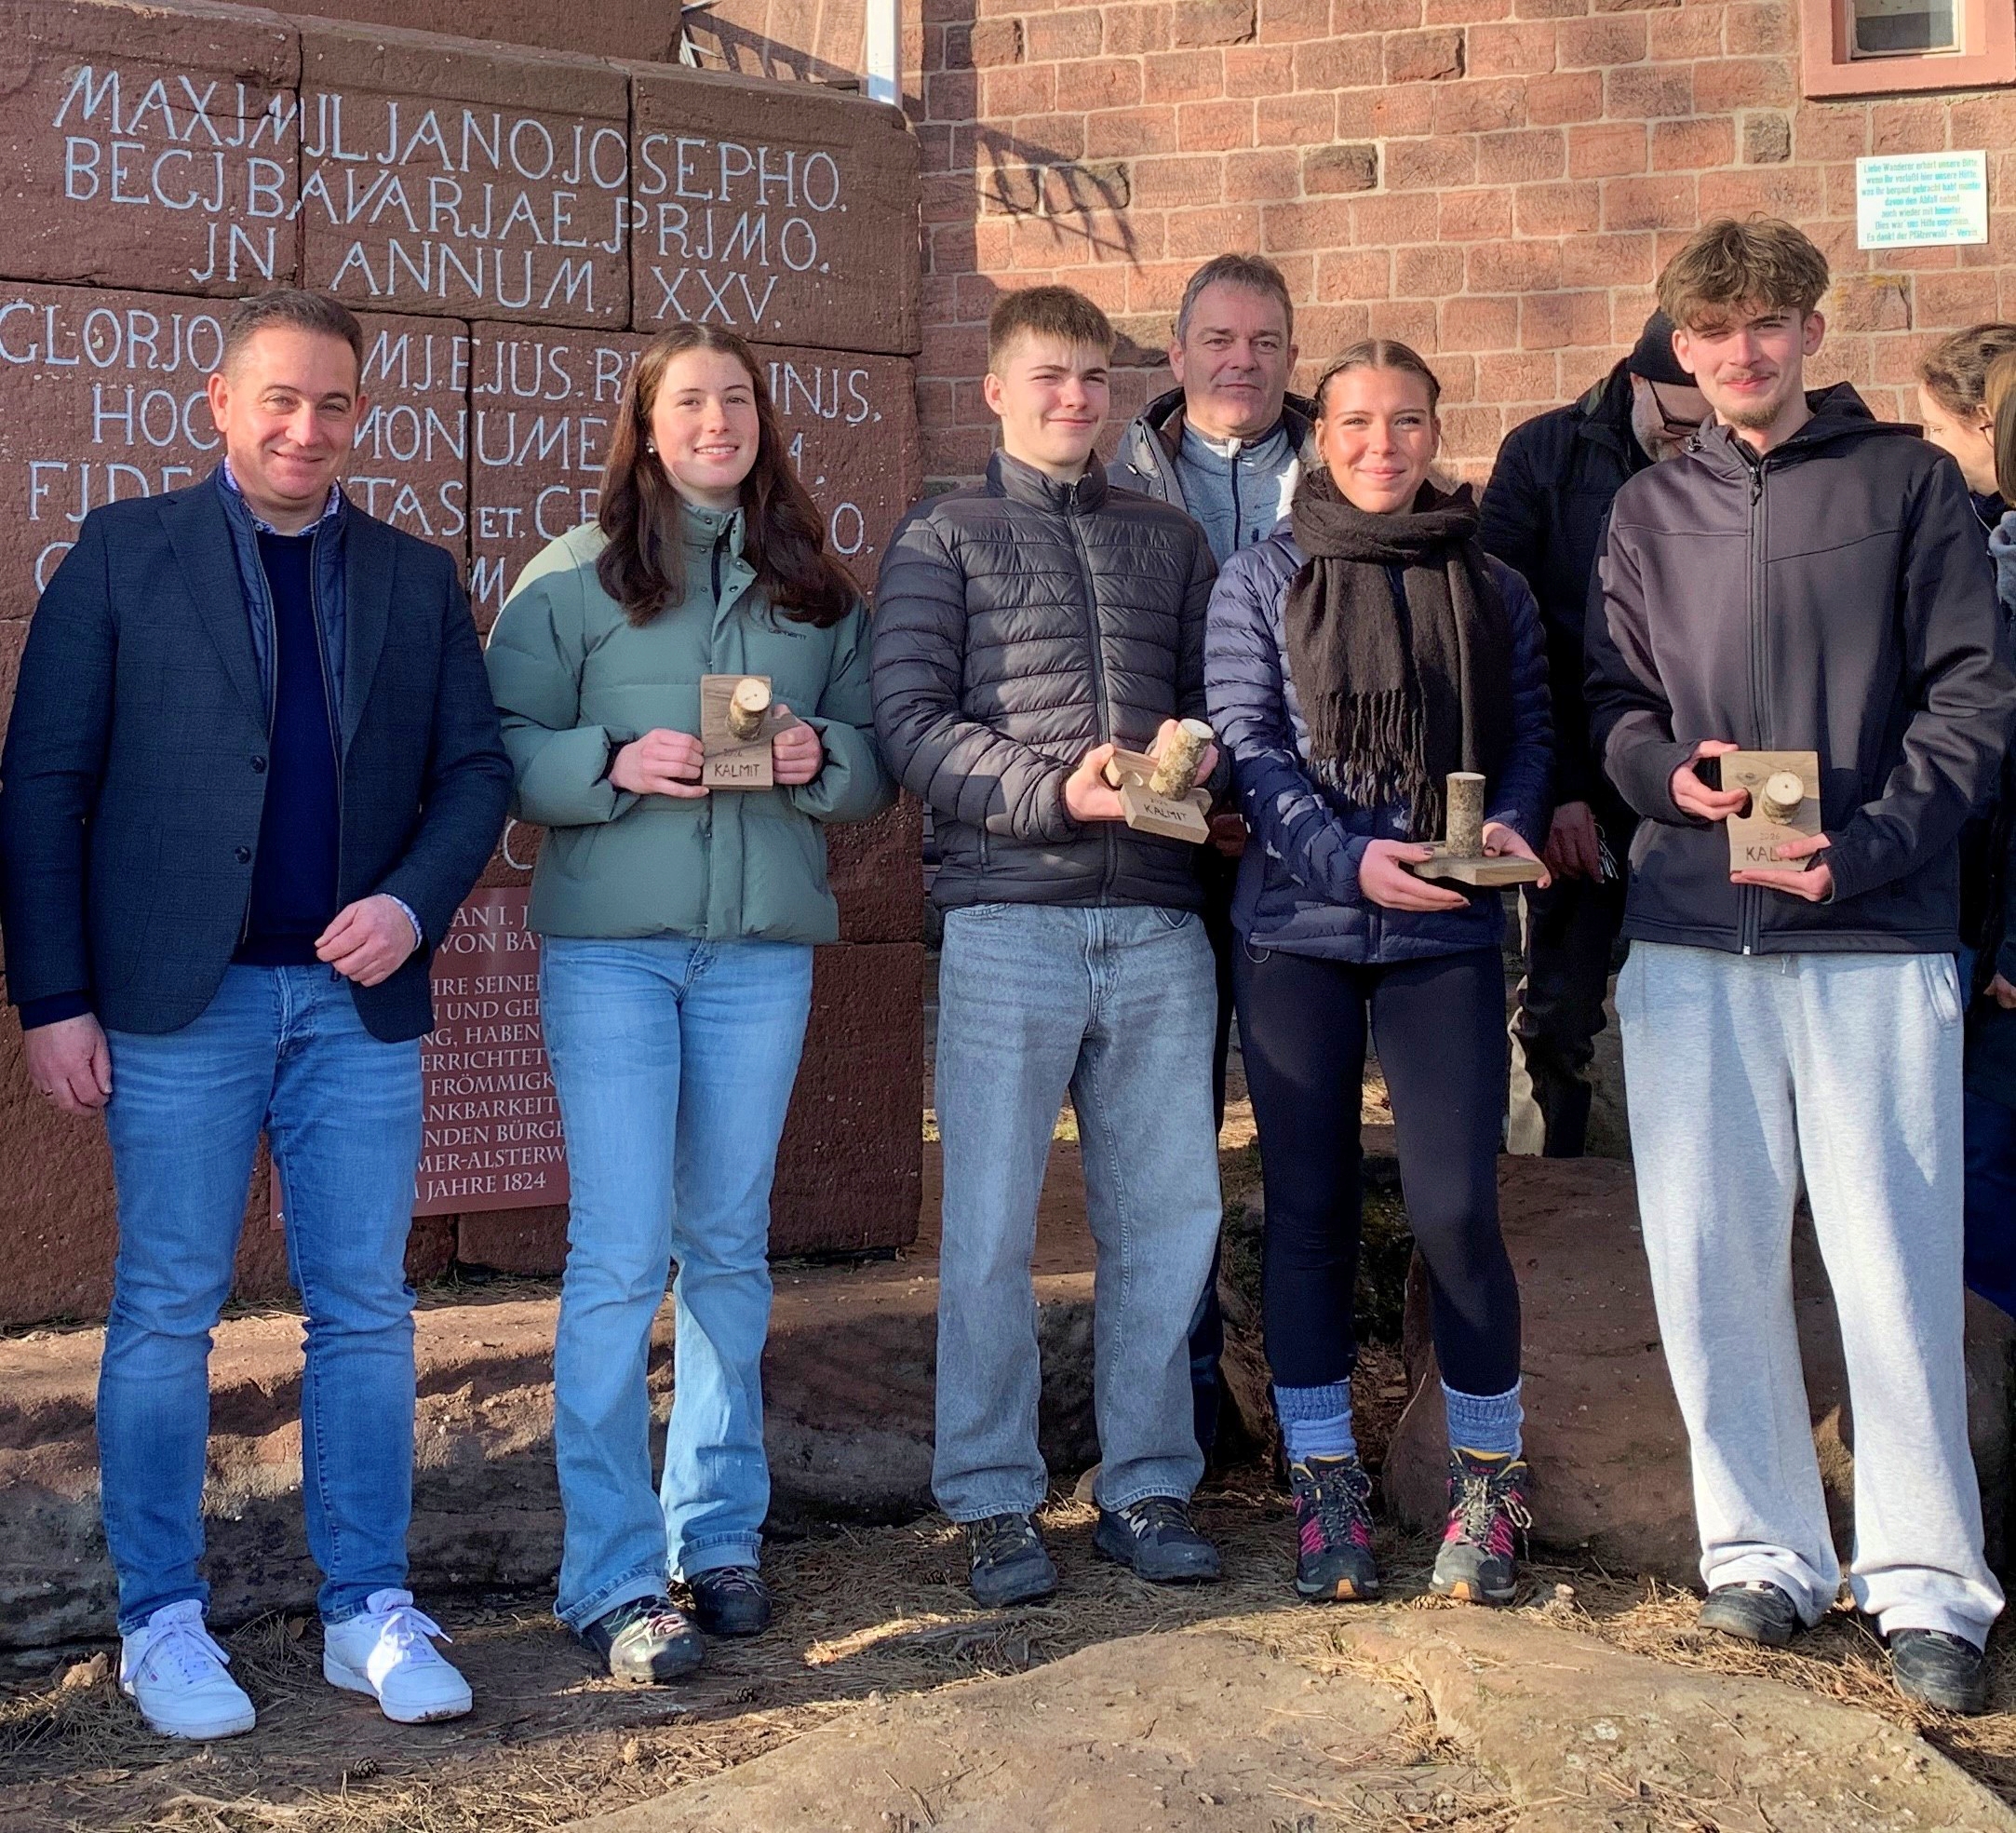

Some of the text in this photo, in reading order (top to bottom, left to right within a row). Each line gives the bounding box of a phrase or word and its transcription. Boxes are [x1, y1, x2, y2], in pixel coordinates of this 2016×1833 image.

[714, 763, 760, 778] KALMIT
[1143, 803, 1187, 821] KALMIT
[448, 1000, 499, 1021] UND
[465, 1024, 541, 1045] HABEN
[421, 1047, 546, 1072] ERRICHTET
[426, 1175, 497, 1204] JAHRE
[503, 1170, 546, 1193] 1824
